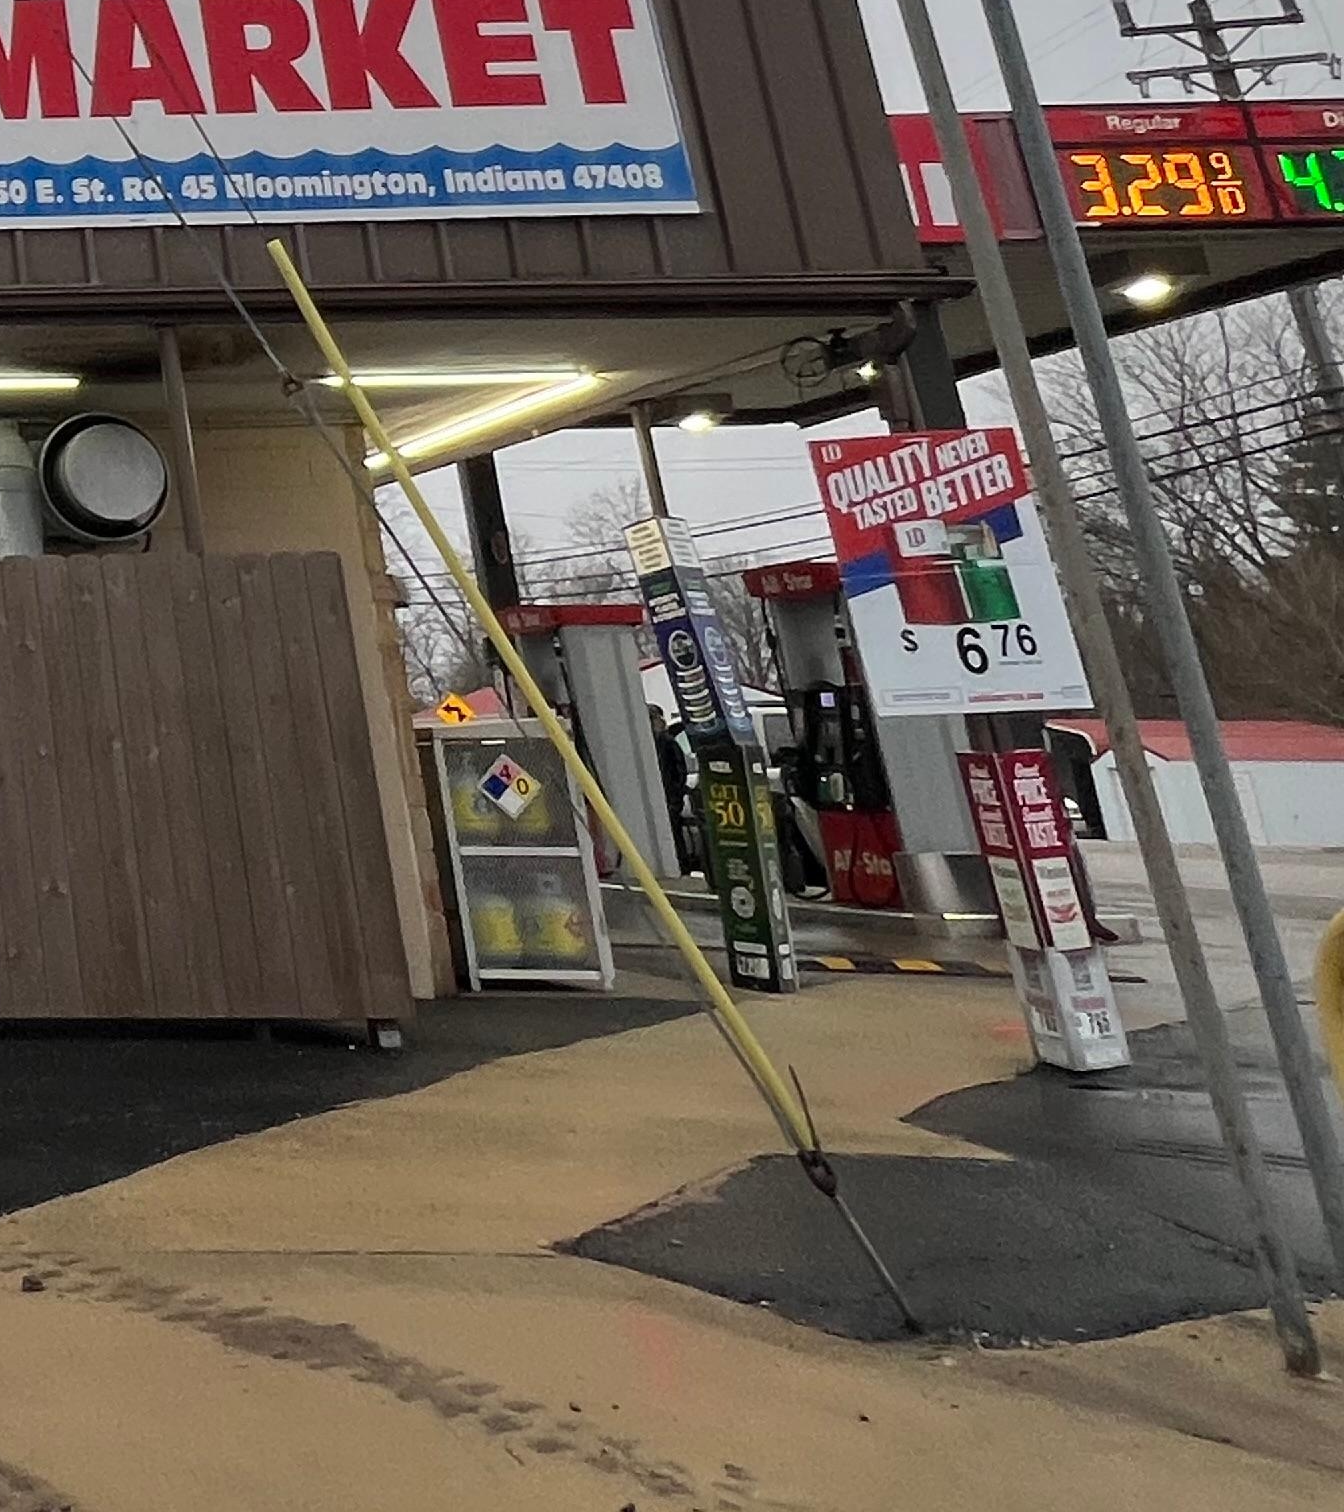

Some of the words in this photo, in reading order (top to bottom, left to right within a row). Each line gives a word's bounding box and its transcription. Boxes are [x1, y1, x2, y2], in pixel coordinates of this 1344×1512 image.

[1105, 114, 1183, 135] Regular
[35, 177, 65, 204] E.
[72, 175, 114, 204] St.
[122, 174, 174, 202] Rd.
[180, 173, 218, 201] 45
[224, 168, 437, 201] Bloomington,
[443, 165, 565, 194] Indiana
[572, 162, 665, 191] 47408
[826, 441, 933, 514] QUALITY
[934, 431, 991, 472] NEVER
[852, 487, 918, 530] TASTED
[919, 453, 1014, 518] BETTER
